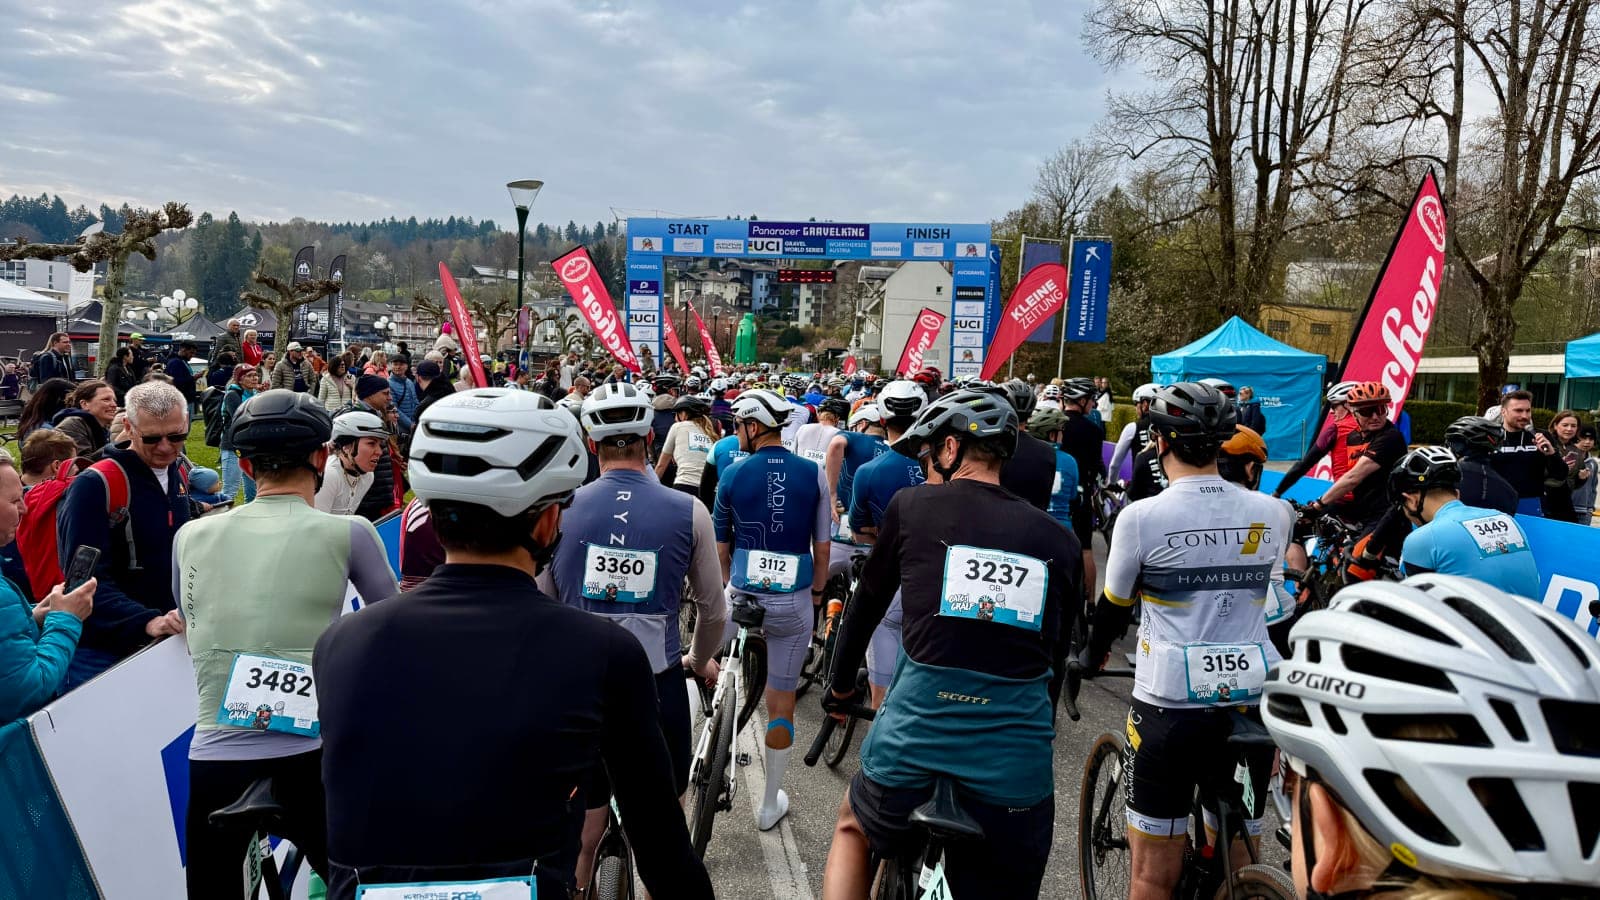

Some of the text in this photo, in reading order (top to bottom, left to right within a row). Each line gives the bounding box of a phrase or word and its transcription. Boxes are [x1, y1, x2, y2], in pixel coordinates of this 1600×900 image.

[668, 224, 710, 235] START
[802, 226, 865, 237] GRAVELKING
[906, 228, 950, 240] FINISH
[753, 240, 780, 252] UCI
[1010, 278, 1058, 321] KLEINE
[1078, 269, 1092, 336] FALKENSTEINER
[1018, 288, 1064, 330] ZEITUNG
[634, 314, 656, 323] UCI
[959, 320, 980, 328] UCI
[1382, 255, 1438, 408] cher
[770, 472, 786, 532] RADIUS
[1474, 520, 1508, 536] 3449
[595, 556, 644, 576] 3360
[759, 557, 786, 572] 3112
[964, 558, 1030, 588] 3237
[1178, 572, 1265, 584] HAMBURG
[1202, 653, 1250, 672] 3156
[246, 668, 312, 698] 3482
[1306, 673, 1366, 700] GIRO
[936, 691, 992, 704] SCOTT
